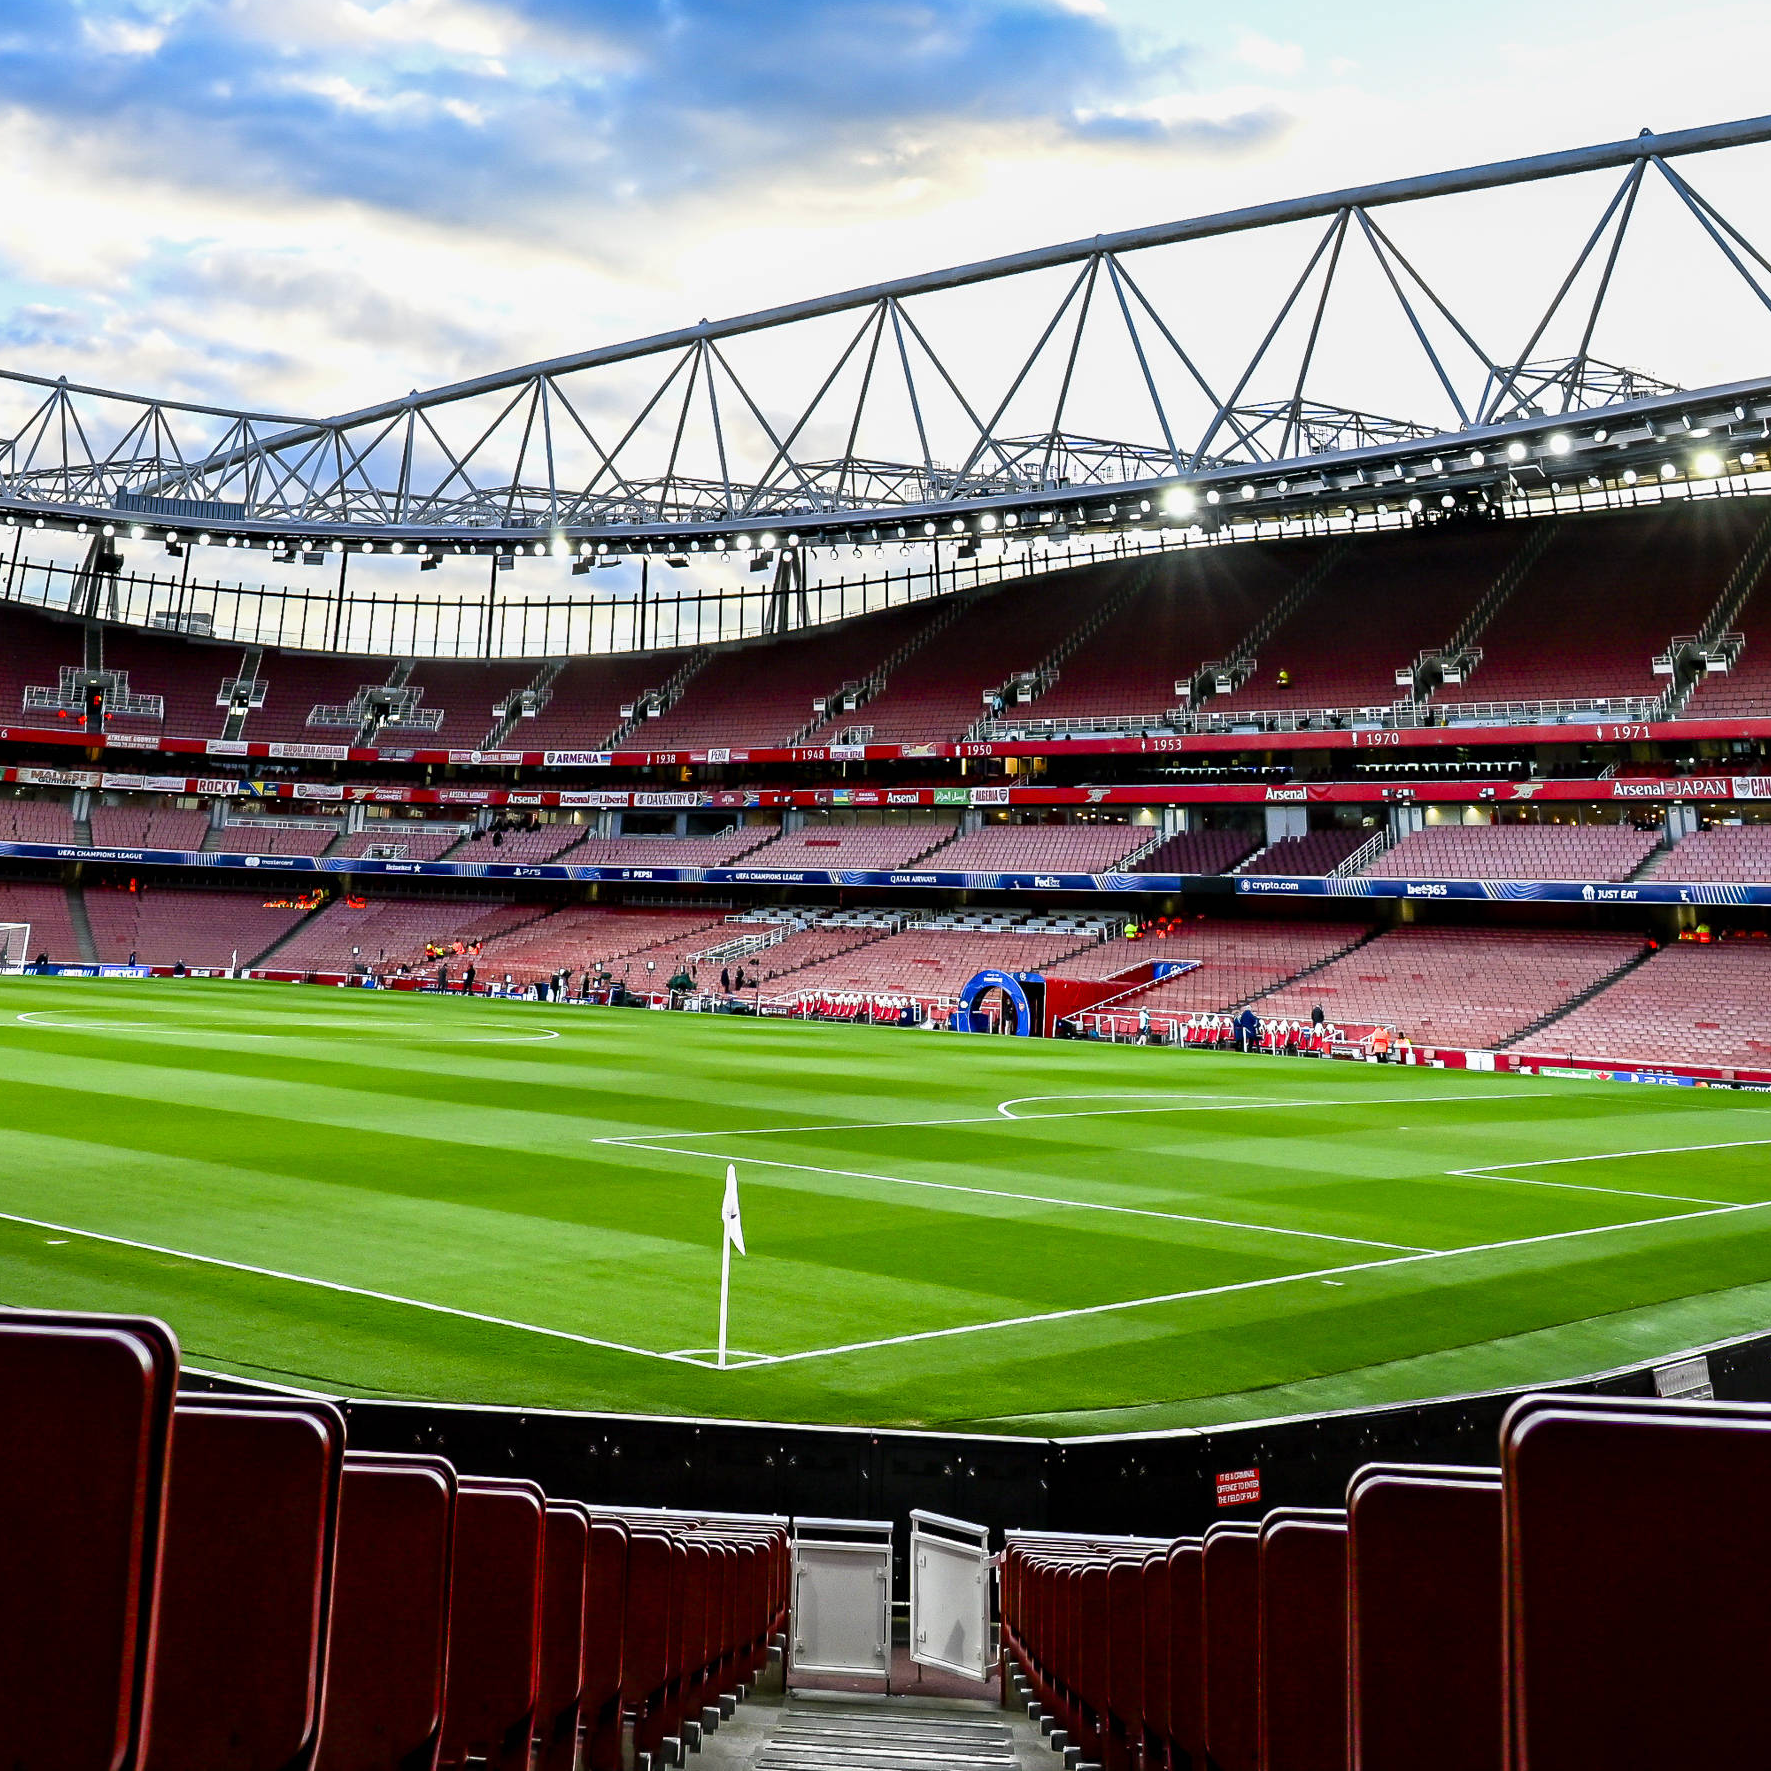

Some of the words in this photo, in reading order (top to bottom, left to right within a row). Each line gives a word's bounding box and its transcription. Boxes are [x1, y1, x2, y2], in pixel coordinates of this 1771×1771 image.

[1613, 726, 1651, 739] 1971
[1367, 733, 1399, 745] 1970
[283, 745, 302, 753] GOOD
[967, 745, 992, 755] 1950
[1153, 739, 1182, 751] 1953
[556, 754, 599, 764] ARMENIA
[656, 754, 675, 764] 1938
[711, 749, 727, 760] PERU
[802, 750, 825, 760] 1948
[31, 770, 87, 782] MALTESE
[38, 776, 75, 785] Gunners
[199, 780, 238, 794] ROCKY
[1614, 781, 1665, 796] Arsenal
[1675, 780, 1727, 796] JAPAN
[507, 792, 541, 804] Arsenal
[560, 794, 591, 804] Arsenal
[599, 794, 628, 804] Liberia
[887, 792, 919, 803] Arsenal
[976, 790, 998, 801] ALGERIA
[1265, 786, 1307, 801] Arsenal
[646, 794, 687, 805] DAVENTRY
[57, 850, 75, 858] UEFA
[76, 850, 116, 859] CHAMPIONS
[117, 852, 143, 860] LEAGUE
[523, 868, 540, 876] PS5
[633, 870, 652, 878] PEPSI
[736, 873, 749, 881] UEFA
[750, 873, 781, 882] CHAMPIONS
[782, 874, 804, 882] LEAGUE
[890, 876, 910, 884] QATAR
[912, 876, 937, 884] AIRWAYS
[1035, 876, 1060, 888] FedEx
[1252, 880, 1299, 893] crypto.com
[1407, 883, 1447, 897] bet365
[1598, 889, 1618, 900] JUST
[1621, 890, 1639, 900] EAT
[1218, 1496, 1227, 1504] THE
